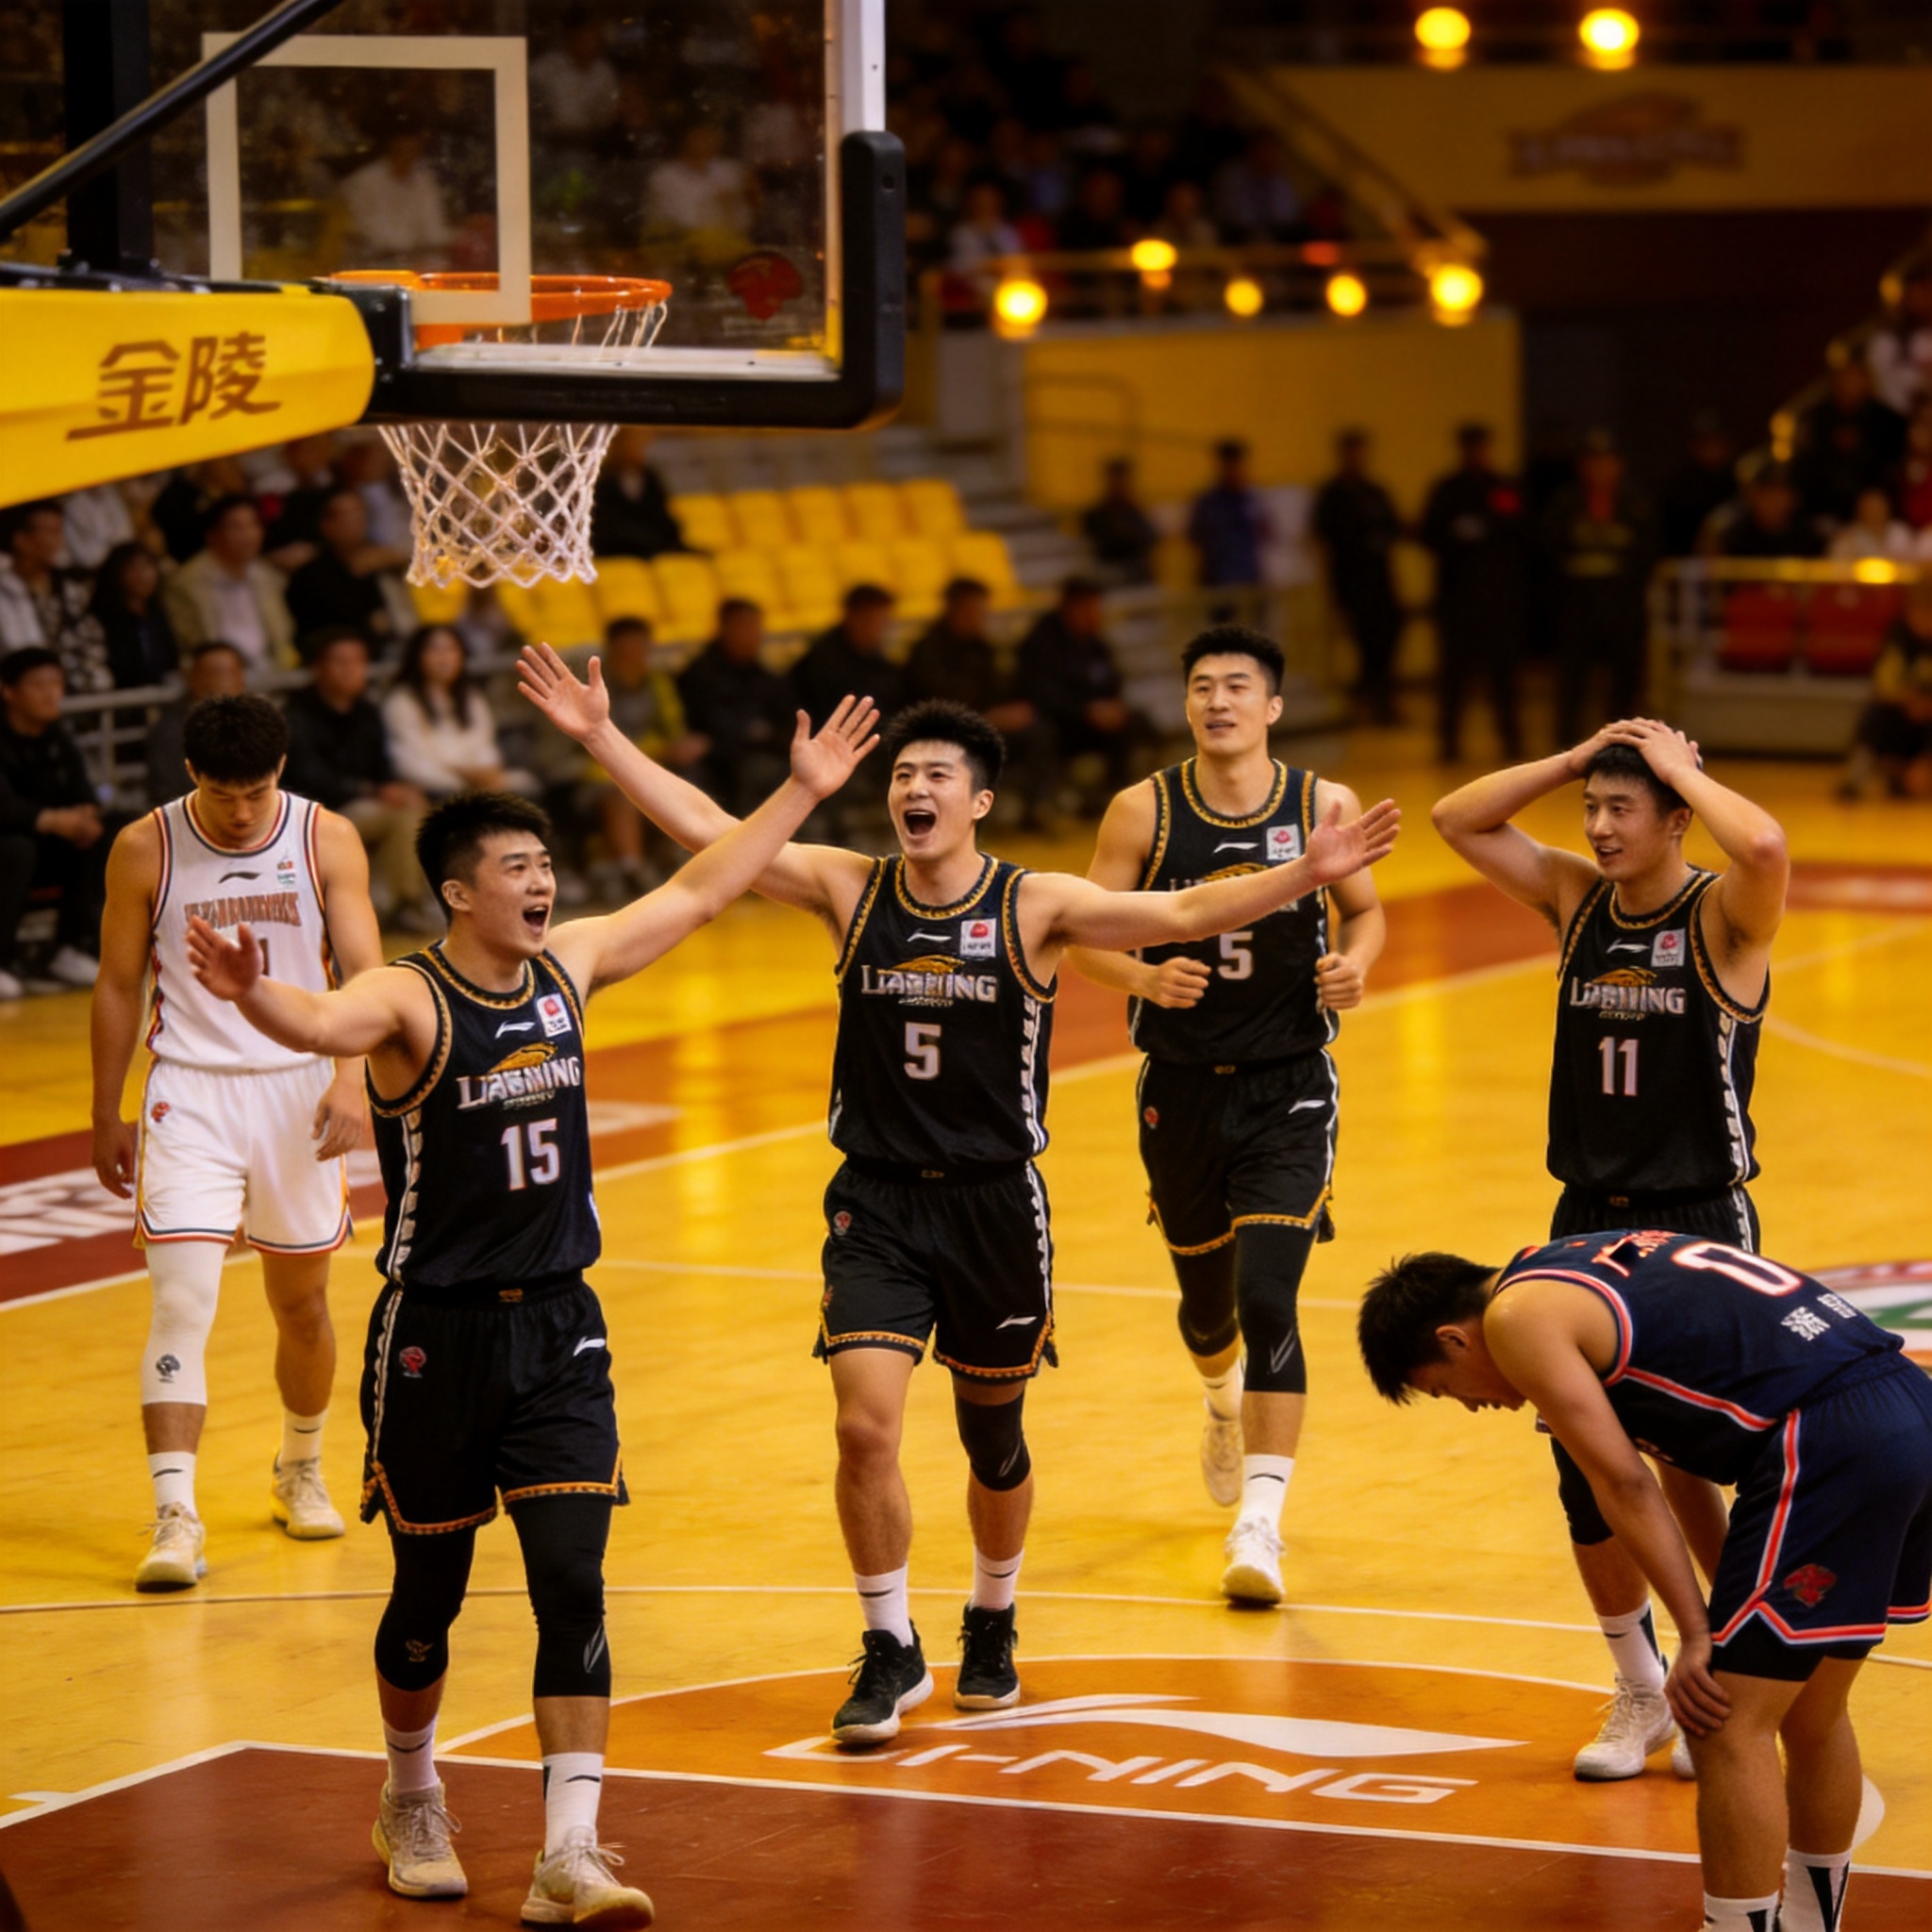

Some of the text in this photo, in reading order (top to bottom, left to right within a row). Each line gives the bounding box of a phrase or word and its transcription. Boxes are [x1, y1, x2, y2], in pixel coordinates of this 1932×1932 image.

[65, 331, 281, 441] 金陵
[1218, 931, 1253, 980] 5
[904, 1021, 941, 1081] 5
[1598, 1037, 1639, 1096] 11
[500, 1117, 560, 1191] 15
[1671, 1241, 1804, 1297] 0
[762, 1736, 1478, 1804] LI-NING
